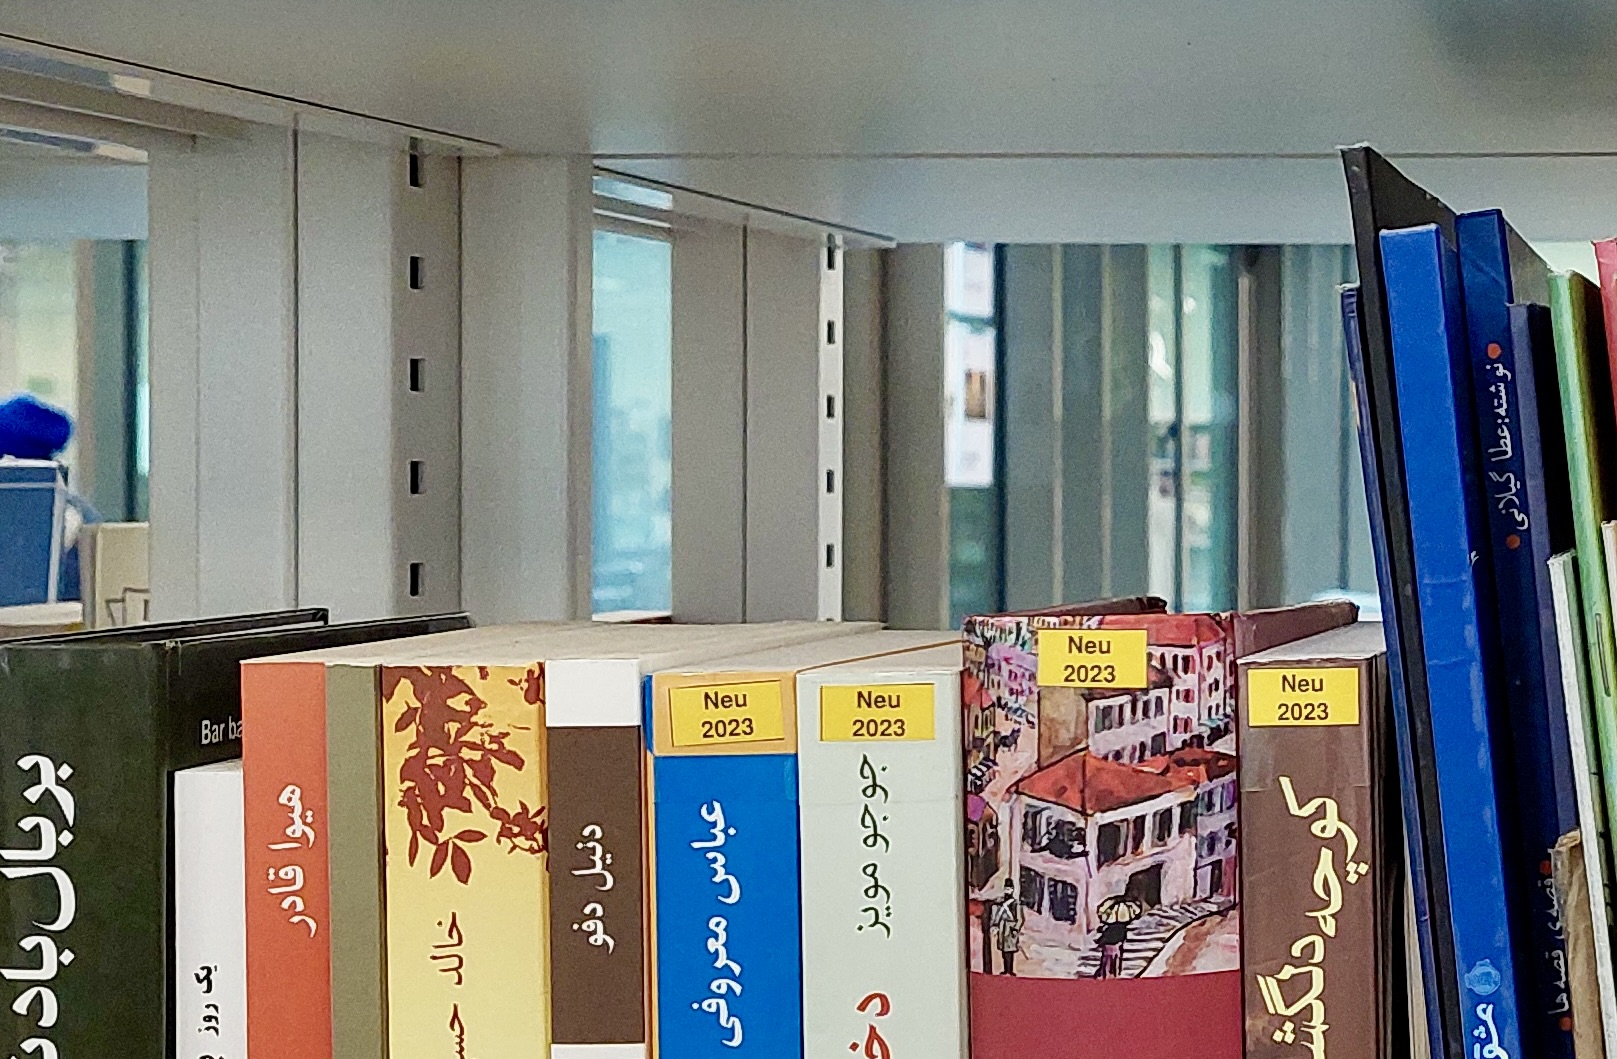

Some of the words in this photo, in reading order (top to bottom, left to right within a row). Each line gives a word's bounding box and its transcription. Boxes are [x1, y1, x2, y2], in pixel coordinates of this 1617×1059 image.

[1067, 635, 1111, 655] Neu
[1063, 664, 1116, 684] 2023
[1281, 673, 1324, 693] Neu
[704, 691, 747, 709] Neu
[857, 691, 901, 709] Neu
[1277, 702, 1329, 722] 2023
[201, 719, 224, 744] Bar
[702, 718, 753, 738] 2023
[852, 719, 906, 737] 2023
[571, 824, 615, 891] دنیل
[690, 800, 741, 904] عباس
[857, 862, 891, 939] مویز
[571, 902, 615, 955] دفو
[429, 911, 464, 987] خالد
[692, 915, 743, 1048] معروفی
[197, 1003, 220, 1035] روز
